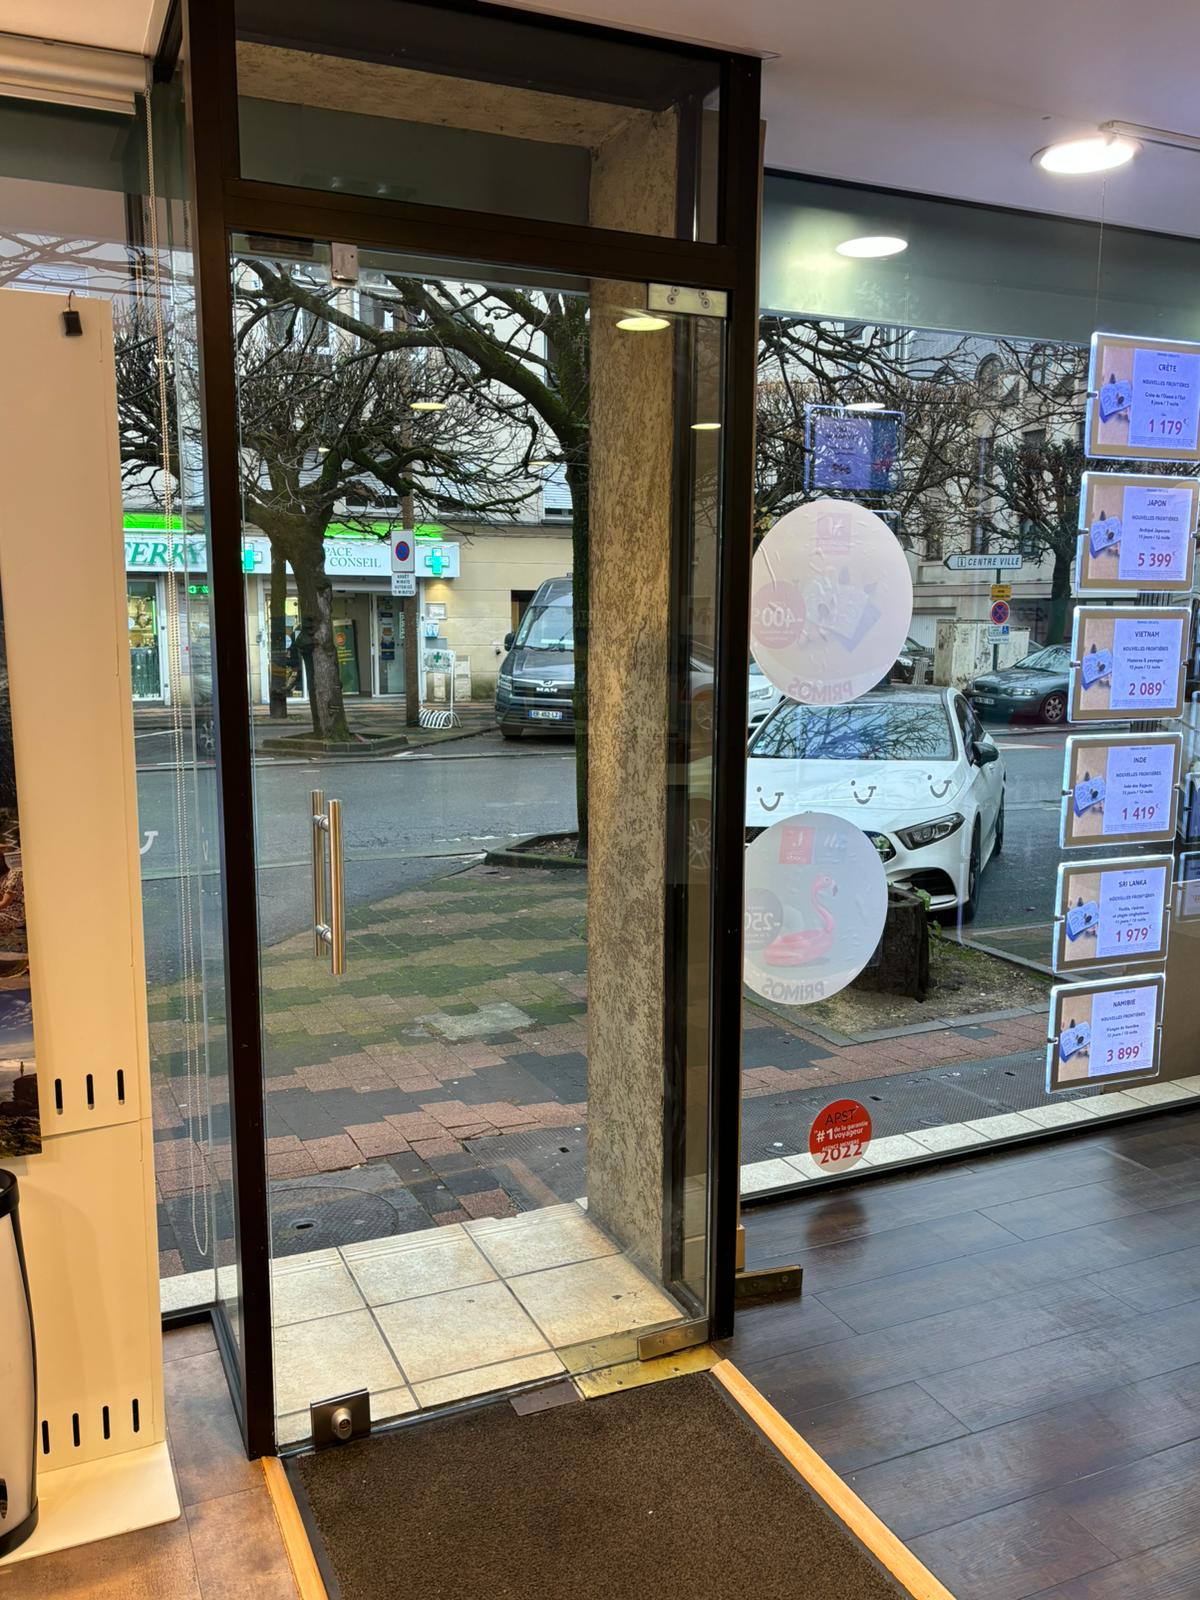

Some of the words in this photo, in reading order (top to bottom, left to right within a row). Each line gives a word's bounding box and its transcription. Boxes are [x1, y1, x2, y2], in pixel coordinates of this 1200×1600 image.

[1158, 361, 1176, 373] CRÈTE
[1149, 418, 1155, 433] 1
[1160, 419, 1183, 435] 179
[1147, 499, 1167, 507] JAPON
[330, 557, 381, 568] CONSEIL
[967, 557, 997, 566] CENTRE
[1000, 557, 1020, 566] VILLE
[1137, 552, 1145, 567] 5
[1149, 552, 1172, 568] 399
[1129, 682, 1136, 696] 2
[1140, 682, 1162, 696] 089
[1133, 756, 1147, 764] INDE
[1122, 807, 1128, 821] 1
[1133, 806, 1155, 820] 419
[1129, 879, 1147, 887] LANKA
[1116, 929, 1121, 943] 1
[1126, 927, 1149, 942] 979
[1113, 999, 1136, 1008] NAMIBIE
[1107, 1049, 1114, 1062] 3
[1117, 1045, 1140, 1060] 899
[825, 1108, 857, 1126] APST
[816, 1128, 834, 1143] #1
[833, 1128, 863, 1139] voyageur
[820, 1143, 862, 1165] 2022
